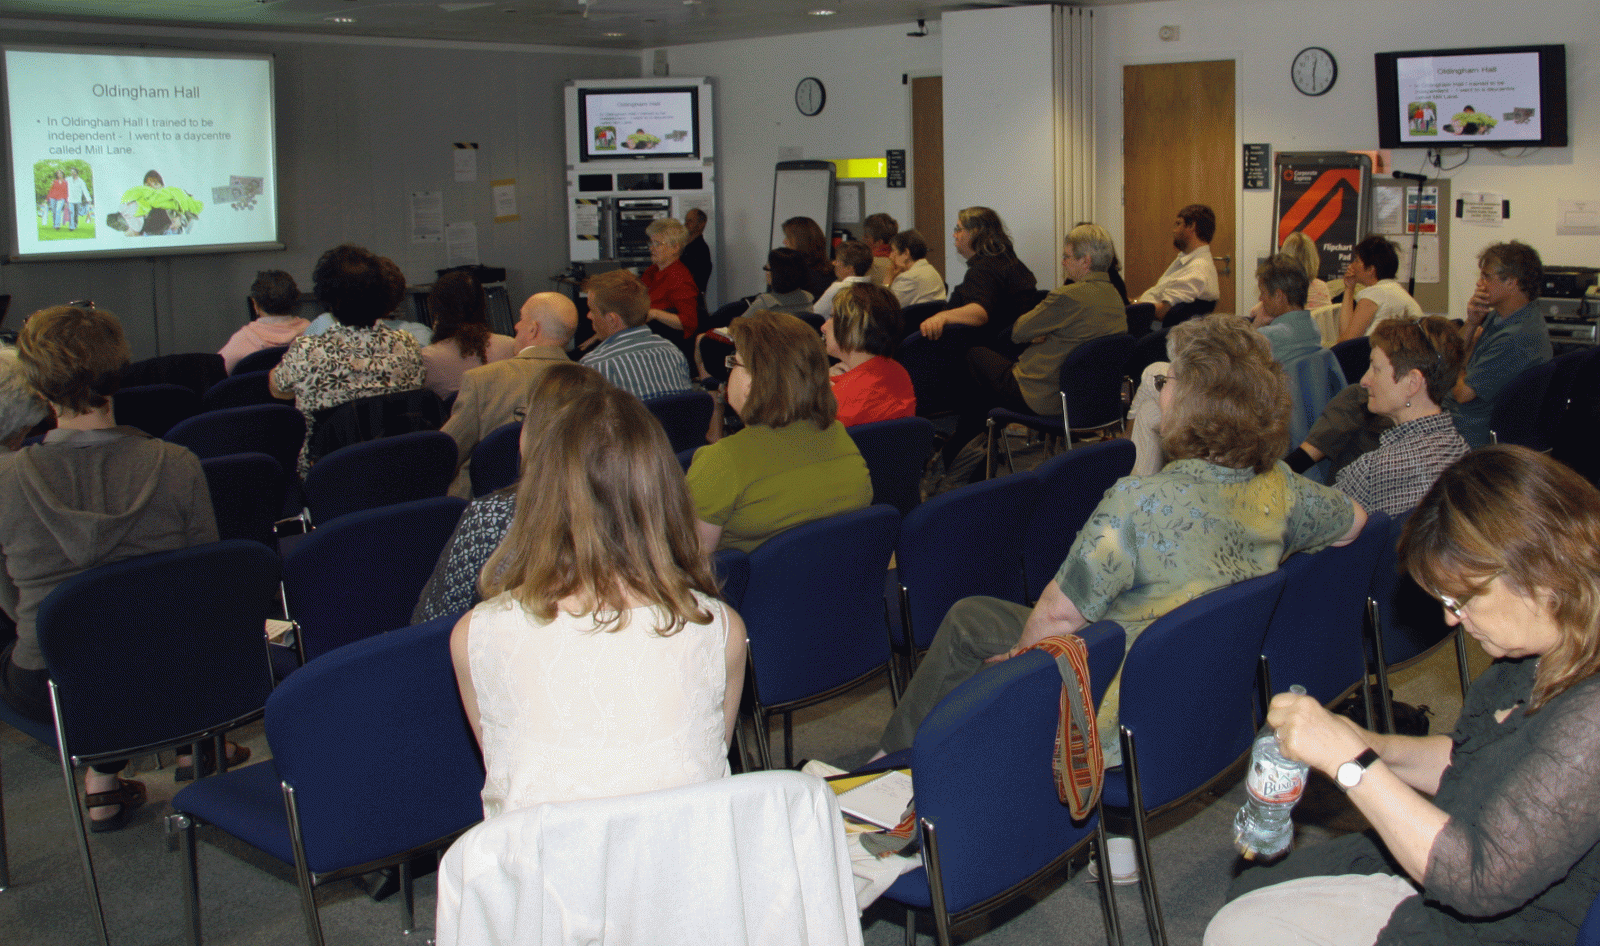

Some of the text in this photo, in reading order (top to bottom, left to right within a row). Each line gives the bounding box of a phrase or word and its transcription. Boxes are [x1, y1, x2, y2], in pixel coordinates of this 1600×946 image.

[92, 84, 201, 101] Oldingham Hall
[47, 116, 58, 126] In
[61, 116, 120, 129] Oldingham
[123, 117, 143, 127] Hall
[152, 118, 187, 127] trained
[189, 118, 199, 127] to
[201, 118, 214, 127] be
[47, 131, 116, 142] independent
[134, 132, 160, 141] went
[162, 132, 172, 140] to
[184, 132, 232, 142] daycentre
[48, 145, 136, 155] called Mill Lane.
[1323, 243, 1353, 252] Flipchart
